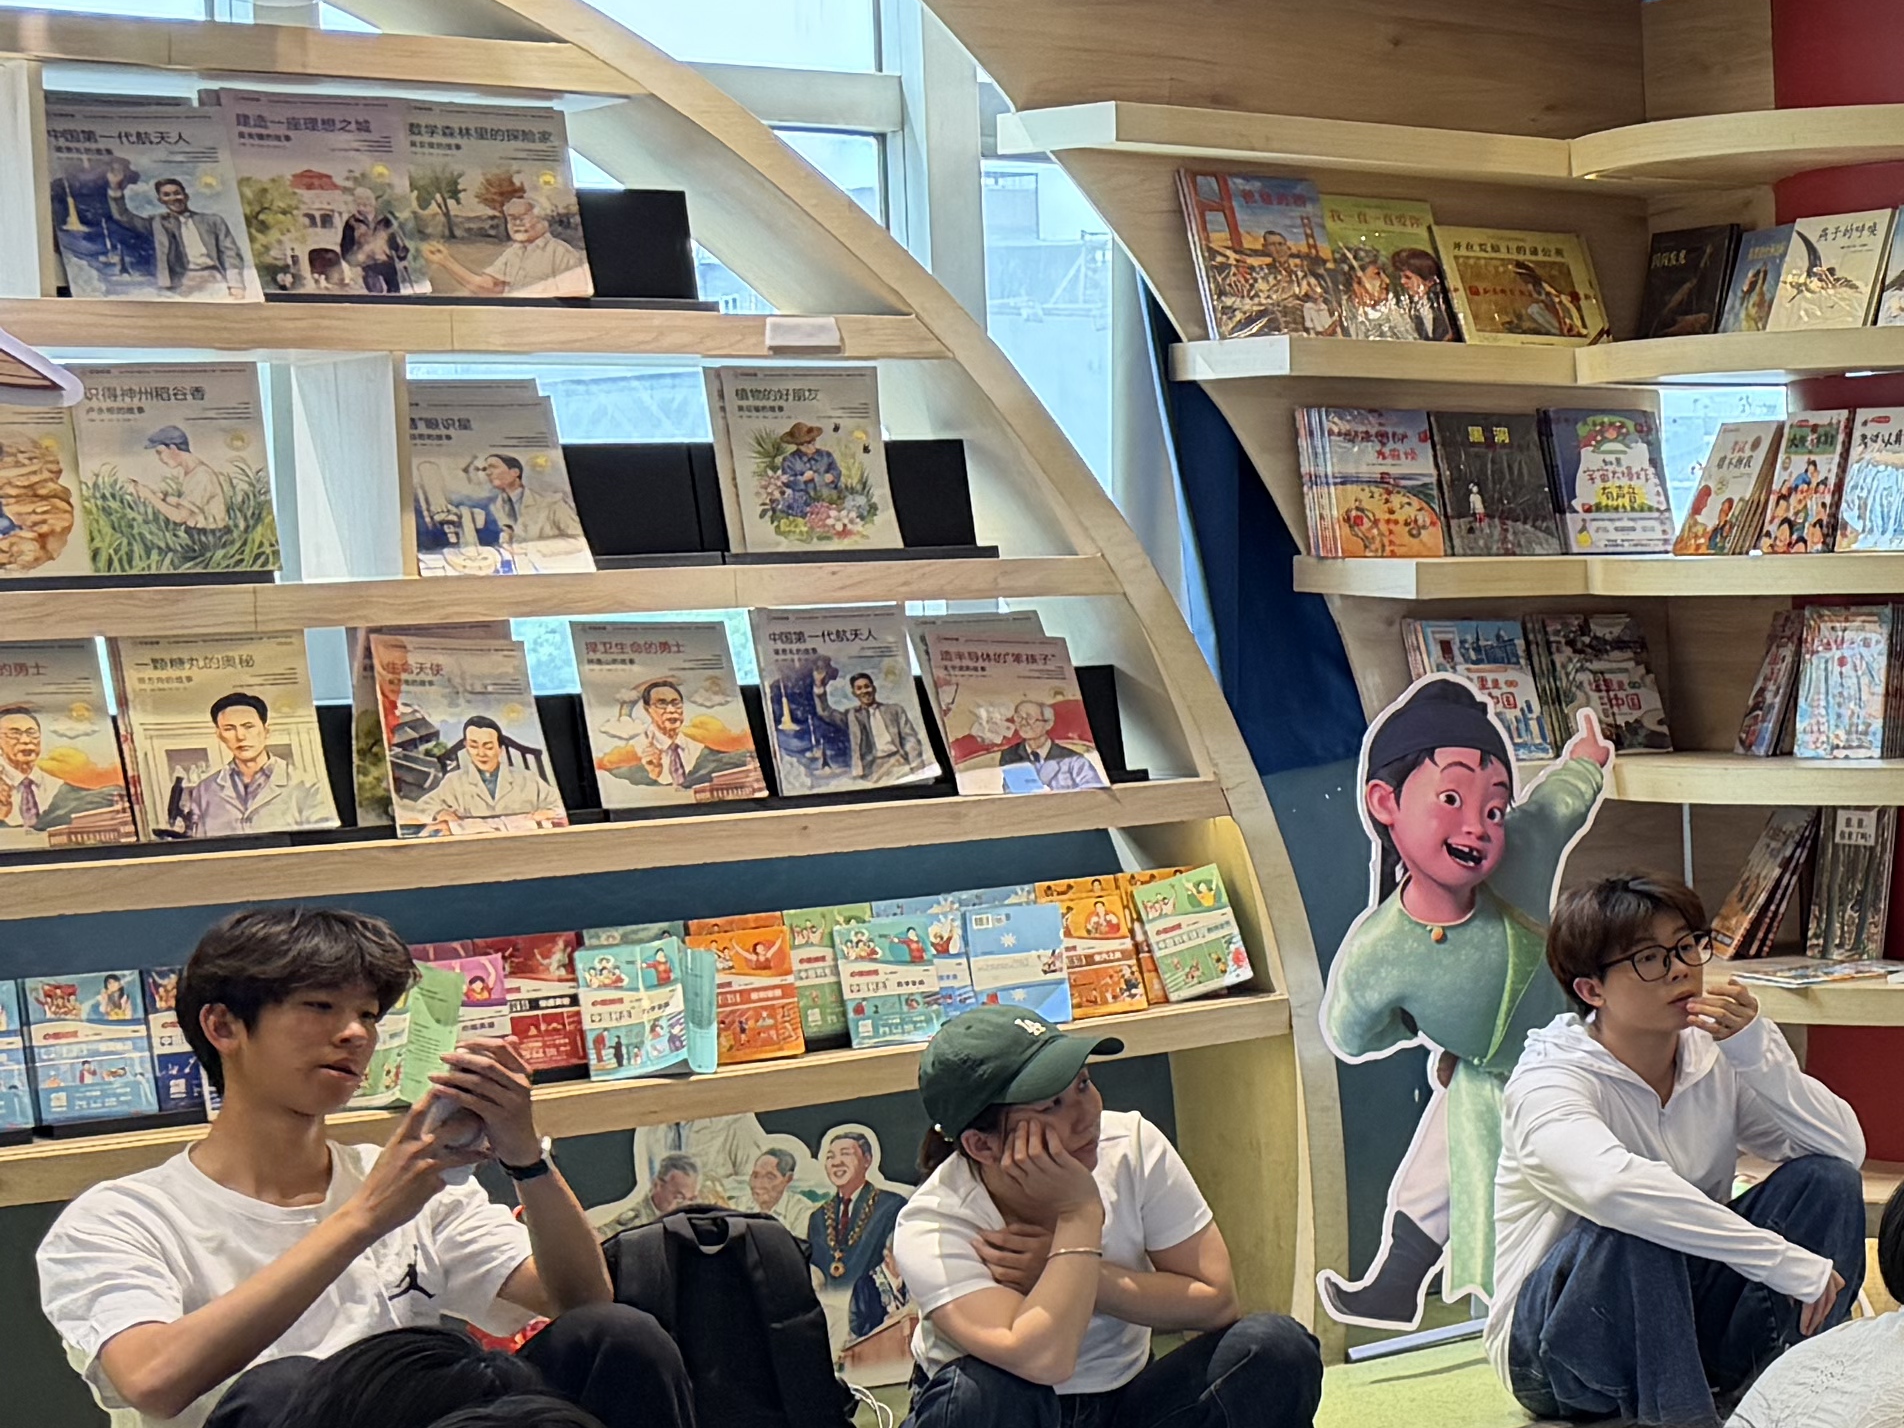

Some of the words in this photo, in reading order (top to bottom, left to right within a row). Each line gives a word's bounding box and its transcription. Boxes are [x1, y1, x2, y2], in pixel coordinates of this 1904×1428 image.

[236, 112, 373, 134] 建造一座理想之城
[46, 128, 192, 147] 中国第一代航天人
[407, 122, 555, 145] 数学森林里的探险家
[735, 387, 821, 403] 植物的好朋友
[768, 627, 878, 643] 中国第一代航天人
[585, 640, 686, 656] 捍卫生命的勇士
[134, 653, 256, 672] 一颗糖丸的奥秘
